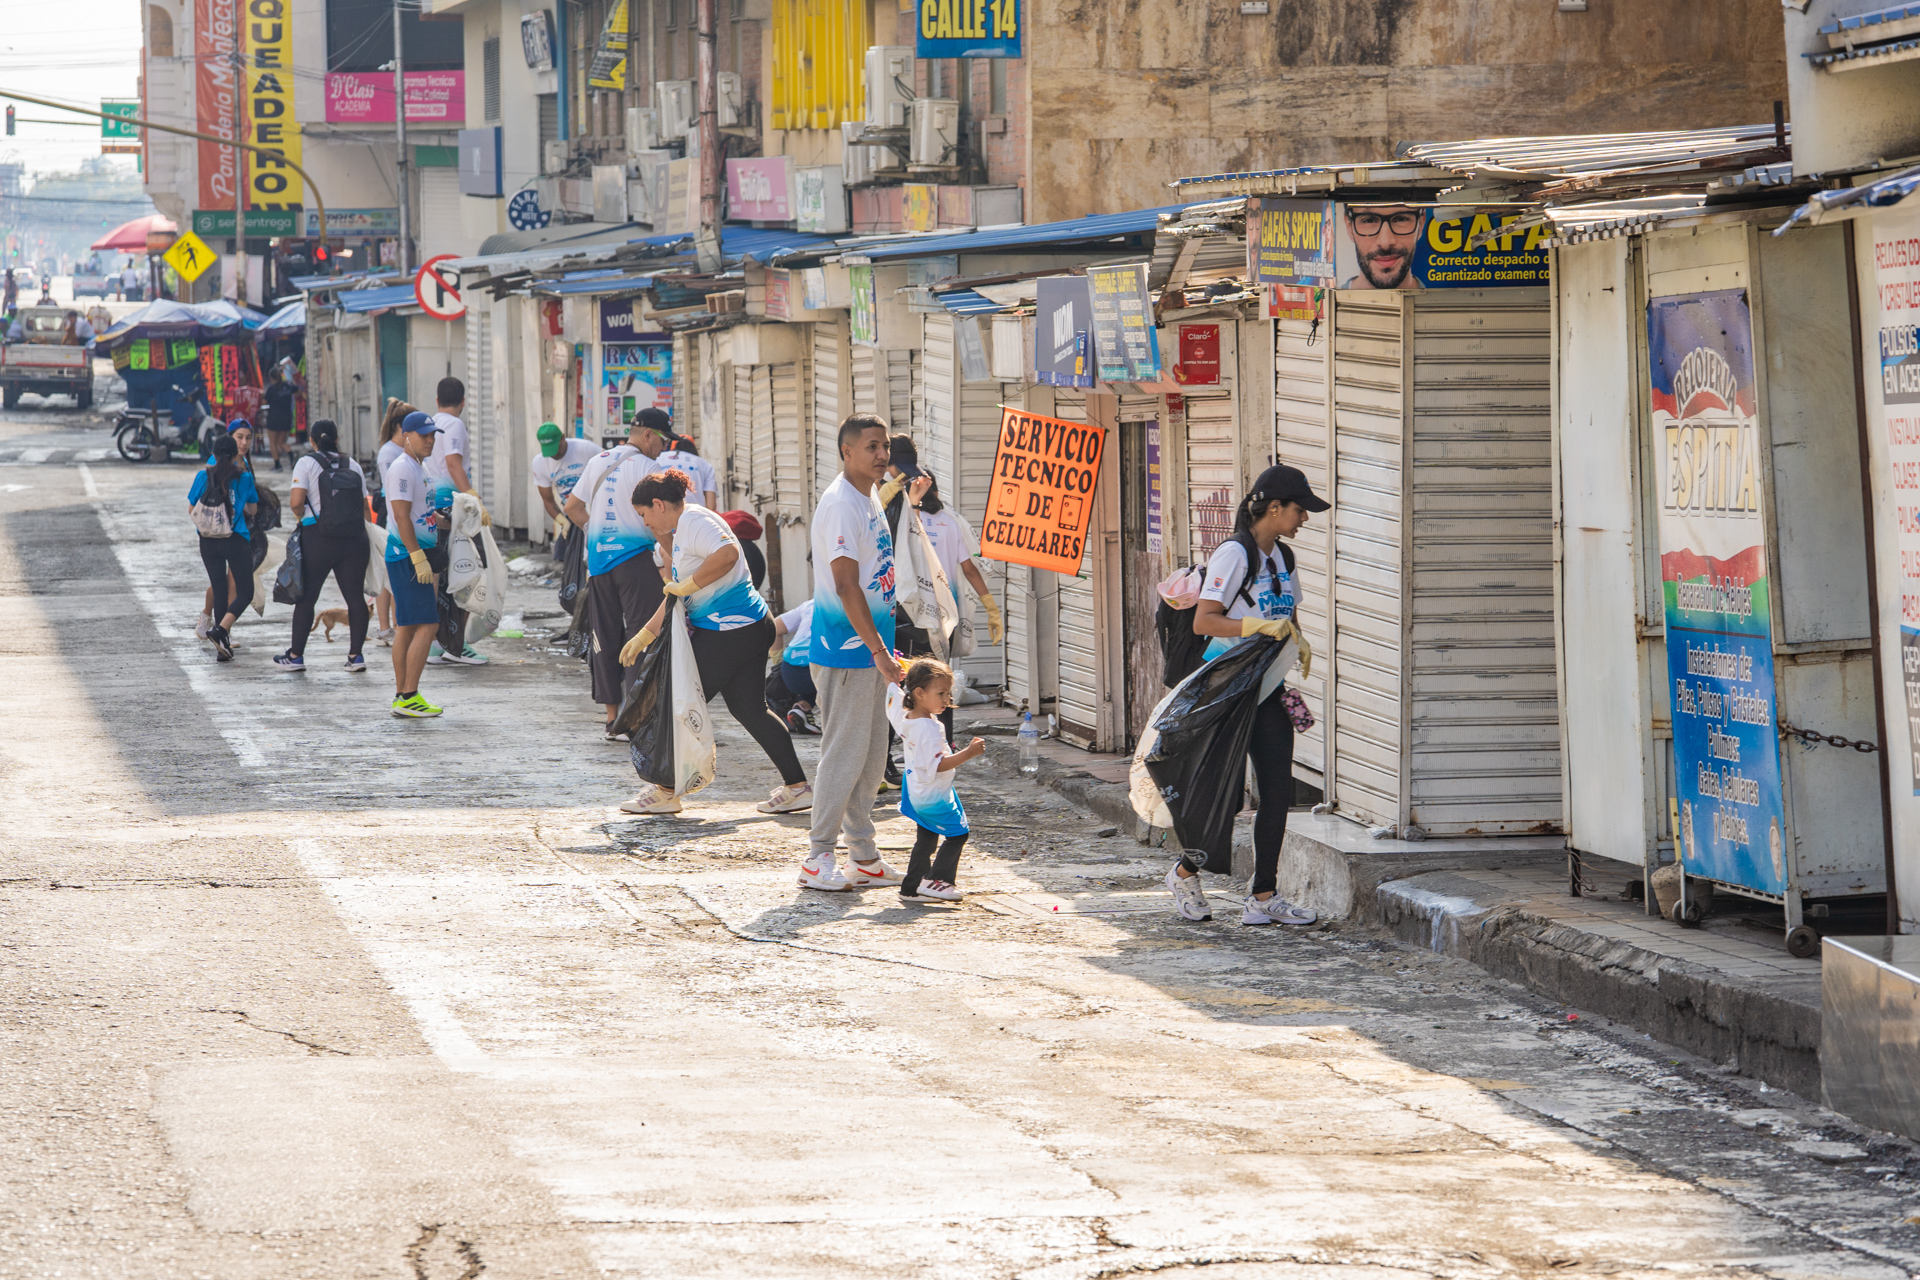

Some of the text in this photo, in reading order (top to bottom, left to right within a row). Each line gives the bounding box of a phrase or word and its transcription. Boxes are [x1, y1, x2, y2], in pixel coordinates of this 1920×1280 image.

[921, 0, 1017, 39] CALLE 14
[331, 75, 375, 99] D'Class
[334, 100, 371, 112] ACADEMIA
[208, 92, 235, 199] Panadería
[1261, 211, 1322, 250] GAFAS SPORT
[1428, 254, 1480, 266] Correcto
[1483, 252, 1540, 268] despacho
[1875, 240, 1907, 269] RELOJES
[436, 266, 460, 307] P
[1427, 267, 1492, 281] Garantizado
[1494, 269, 1536, 280] examen
[1877, 284, 1883, 311] Y
[1188, 332, 1208, 341] Claro
[1881, 325, 1918, 357] PULSOS
[605, 345, 660, 365] R & E
[1673, 346, 1737, 419] RELOJERIA
[1883, 363, 1899, 394] EN
[604, 428, 620, 436] Cel:
[1004, 414, 1099, 465] SERVICIO
[1000, 452, 1092, 494] TECNICO
[1664, 418, 1758, 518] ESPITIA
[1892, 461, 1918, 490] CLASE
[1025, 492, 1054, 520] DE
[985, 519, 1081, 560] CELULARES
[1258, 594, 1294, 611] MUND
[1677, 572, 1752, 624] Reparación de Relojes
[1686, 640, 1752, 682] Instalaciones de:
[1676, 678, 1770, 727] Pilas, Pulsos y Cristales.
[1697, 760, 1759, 807] Gafas, Celulares
[1713, 804, 1750, 850] y Relojes.
